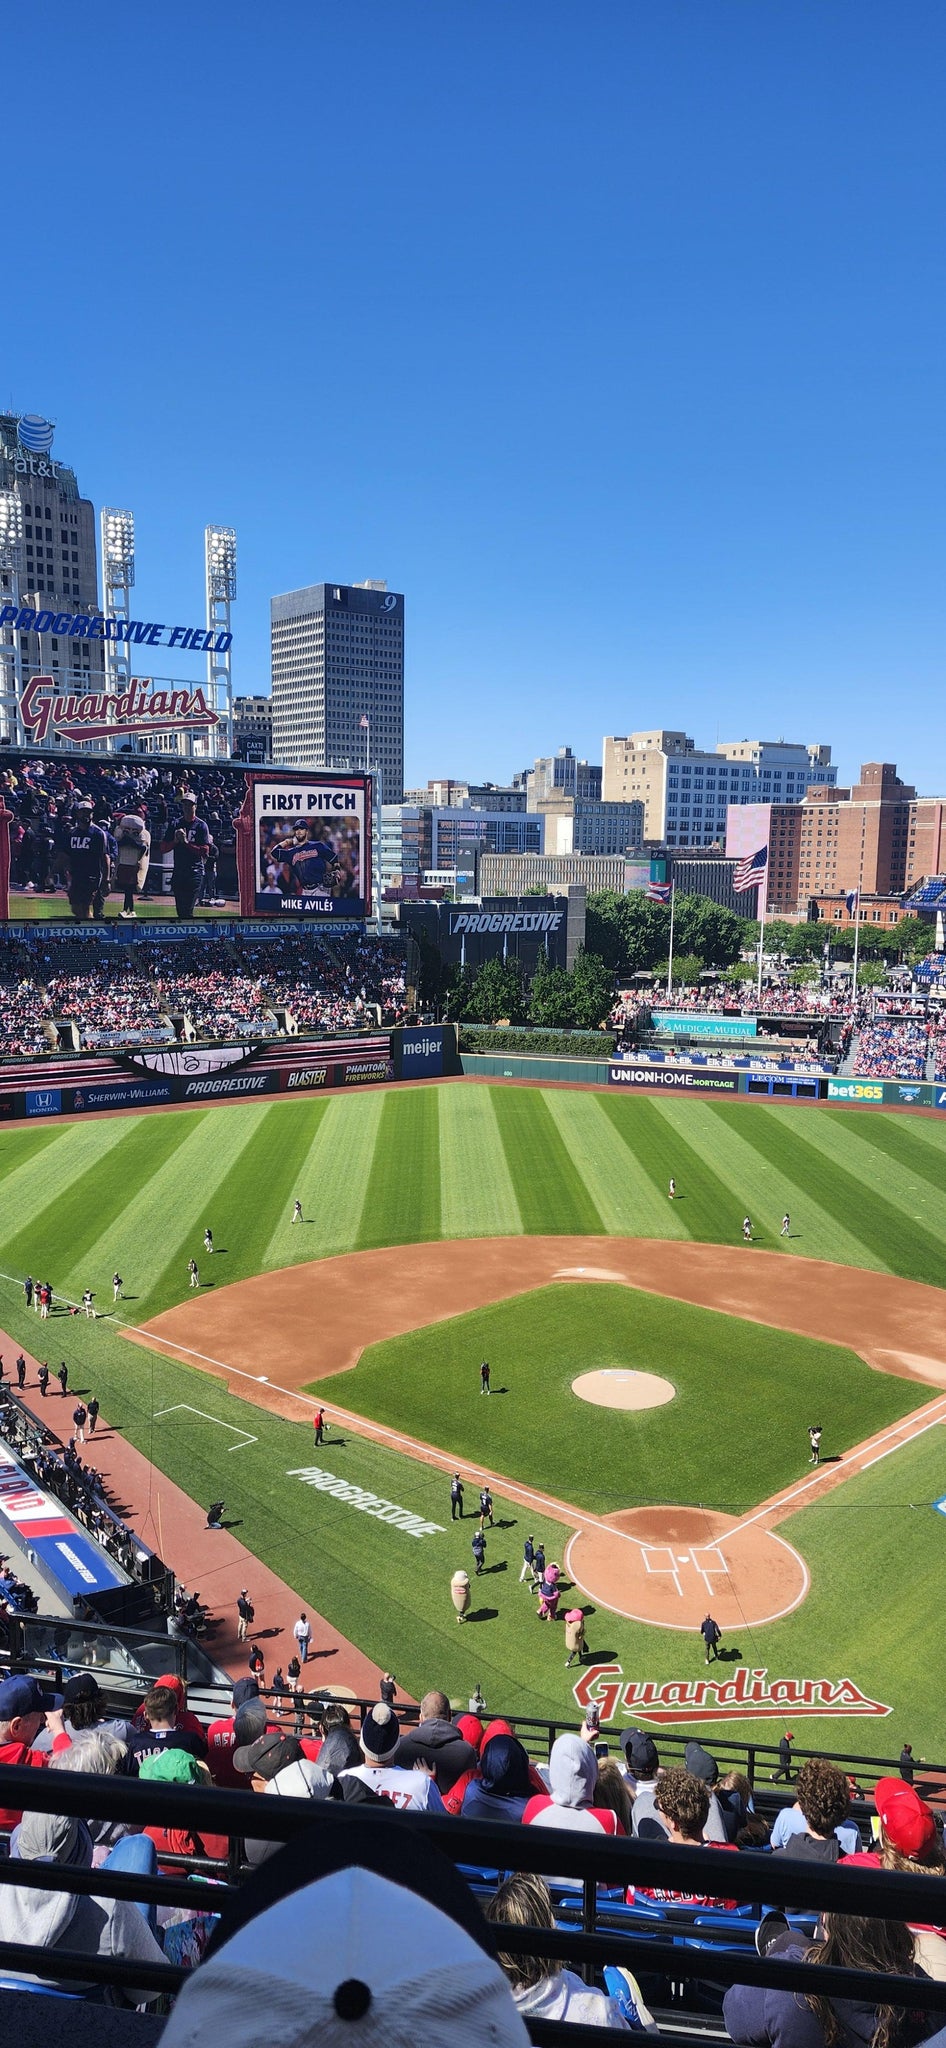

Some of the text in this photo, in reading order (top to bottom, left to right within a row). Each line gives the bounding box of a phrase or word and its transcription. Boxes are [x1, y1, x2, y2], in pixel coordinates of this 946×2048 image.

[15, 456, 59, 479] at&t
[0, 606, 233, 653] PROGRESSIVE FIELD
[19, 675, 219, 743] Guardians
[262, 793, 356, 810] FIRST PITCH
[70, 837, 91, 849] CLE
[281, 898, 333, 912] MIKE AVILÉS
[155, 926, 208, 934] HONDA
[248, 924, 298, 932] HONDA
[314, 923, 360, 931] HONDA
[453, 913, 564, 933] PROGRESSIVE
[49, 928, 109, 936] HONDA
[917, 975, 931, 984] THE
[403, 1038, 442, 1057] meijer
[346, 1062, 386, 1074] PHANTOM
[287, 1069, 327, 1087] BLASTER
[345, 1072, 386, 1083] FIREWORKS
[693, 1079, 735, 1088] MORTGAGE
[752, 1075, 785, 1083] LECOM
[185, 1076, 269, 1095] PROGRESSIVE
[829, 1084, 883, 1099] bet365
[285, 1466, 448, 1538] PROGRESSIVE
[573, 1664, 894, 1725] Guardians
